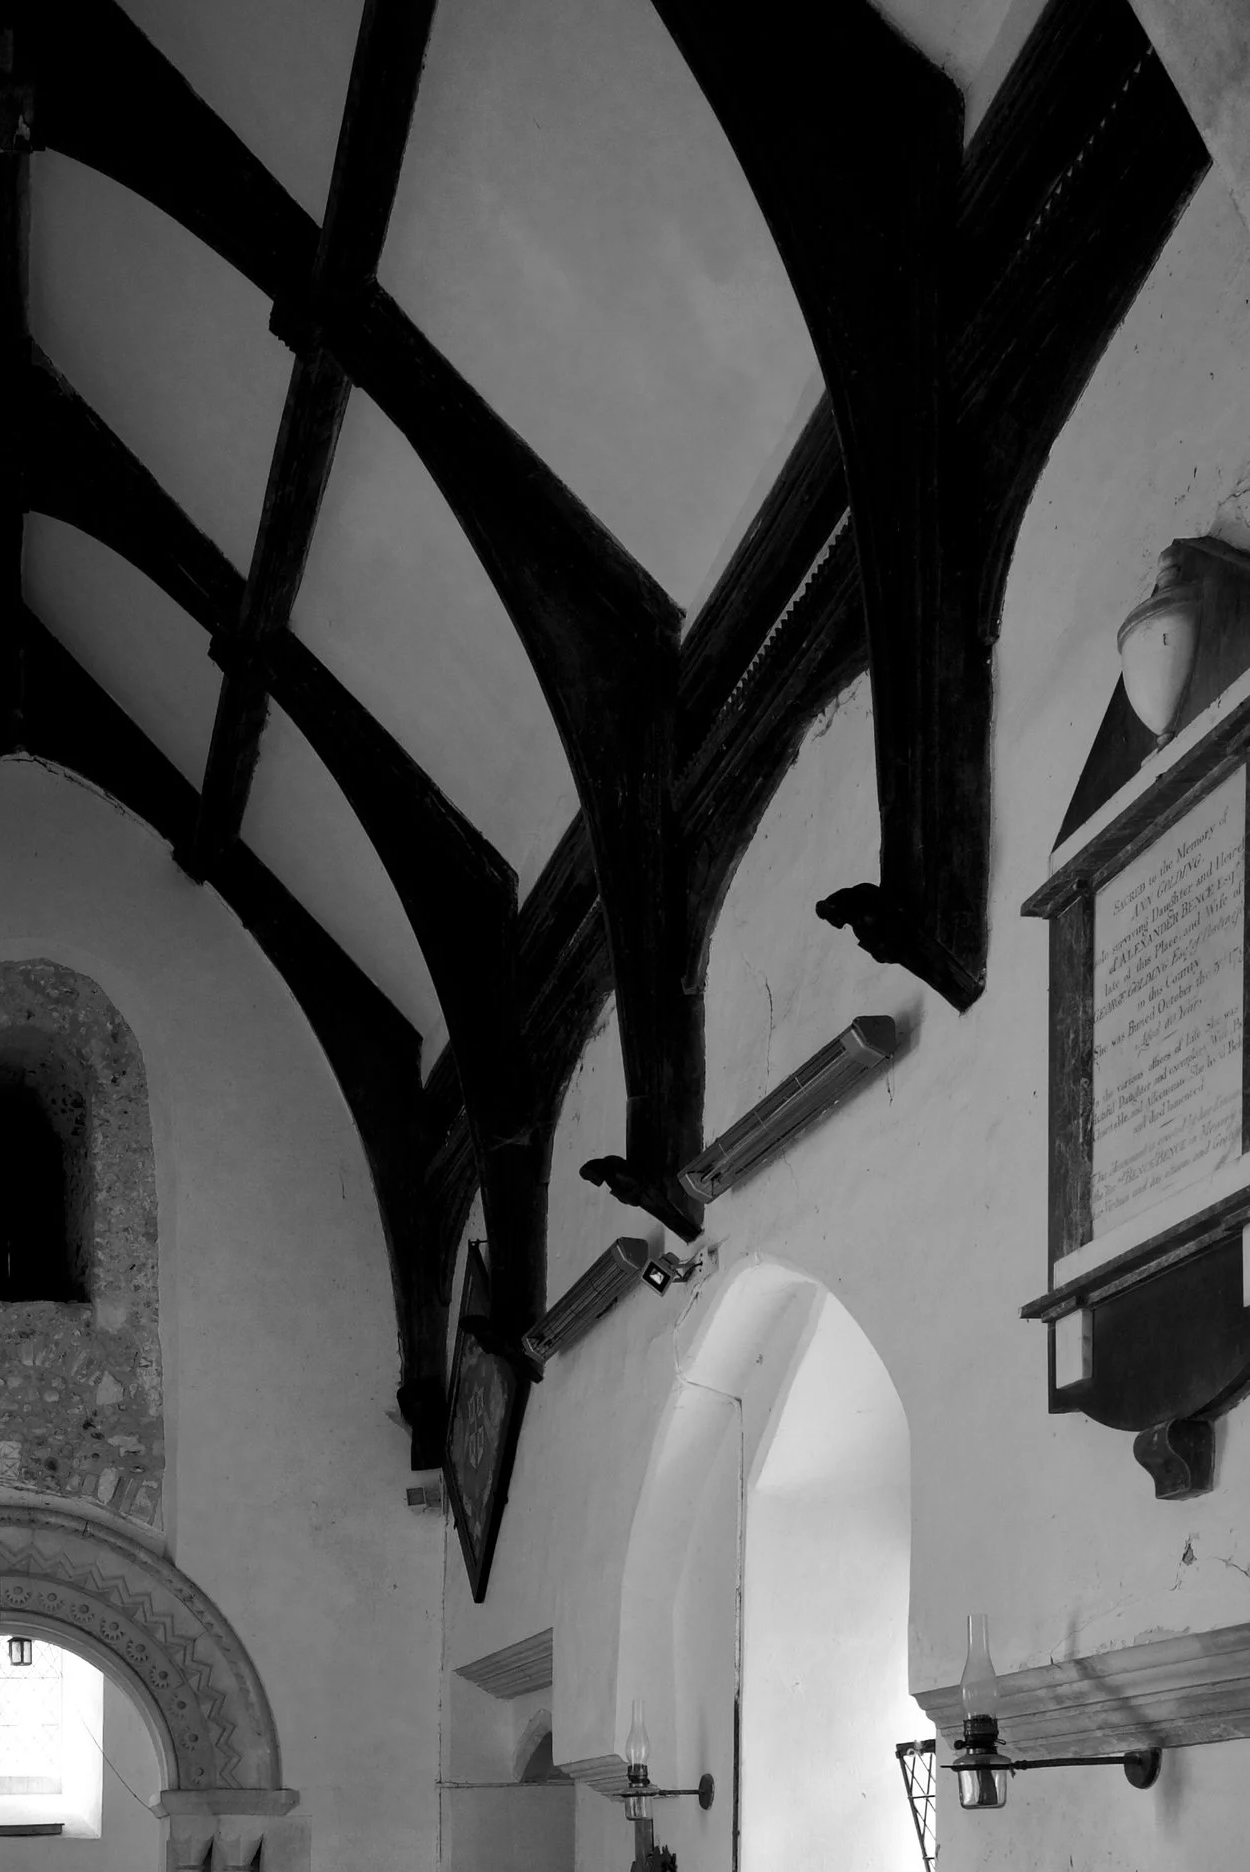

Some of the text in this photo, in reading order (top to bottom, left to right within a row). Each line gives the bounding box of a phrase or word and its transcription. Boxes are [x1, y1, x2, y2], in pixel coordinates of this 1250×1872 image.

[1148, 875, 1157, 886] to
[1160, 860, 1173, 876] the
[1177, 824, 1215, 862] Memory
[1152, 884, 1193, 922] Daughter
[1196, 860, 1212, 886] and
[1183, 911, 1200, 936] and
[1128, 1006, 1155, 1037] Buried
[1158, 985, 1192, 1014] October
